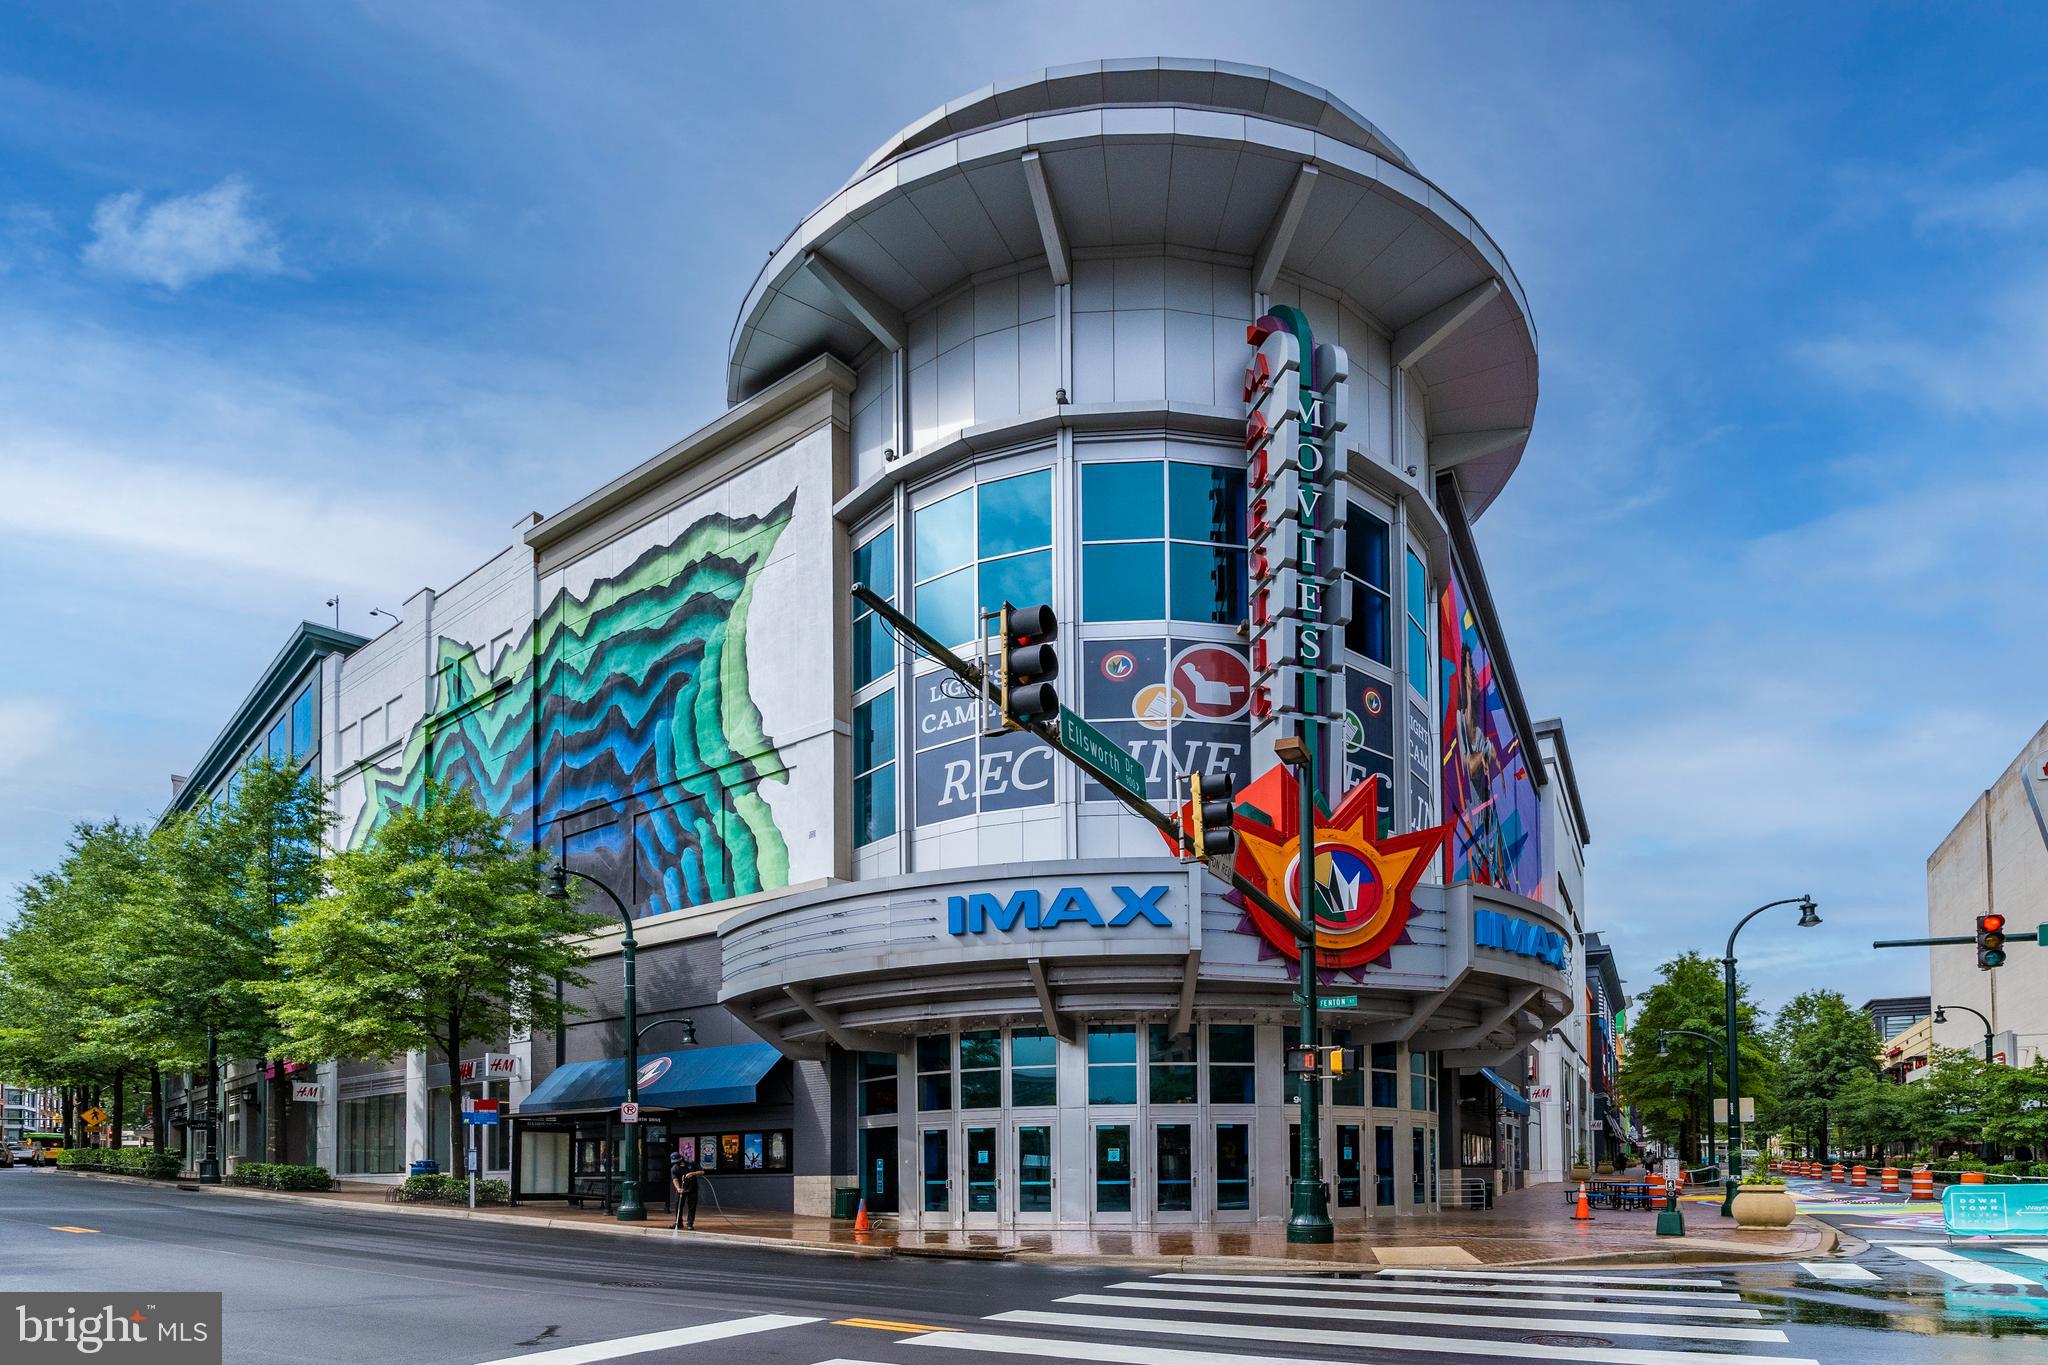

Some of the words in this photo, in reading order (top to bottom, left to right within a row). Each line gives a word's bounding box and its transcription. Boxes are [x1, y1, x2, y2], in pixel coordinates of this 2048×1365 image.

[1297, 399, 1325, 658] MOVIES
[1068, 720, 1120, 774] Ellsworth
[1124, 757, 1134, 775] Dr
[947, 885, 1172, 935] IMAX
[1475, 908, 1567, 971] IMAX
[1320, 997, 1346, 1007] FENTON
[490, 1058, 515, 1073] H&M
[296, 1086, 319, 1098] H&M
[1531, 1088, 1550, 1099] H&M
